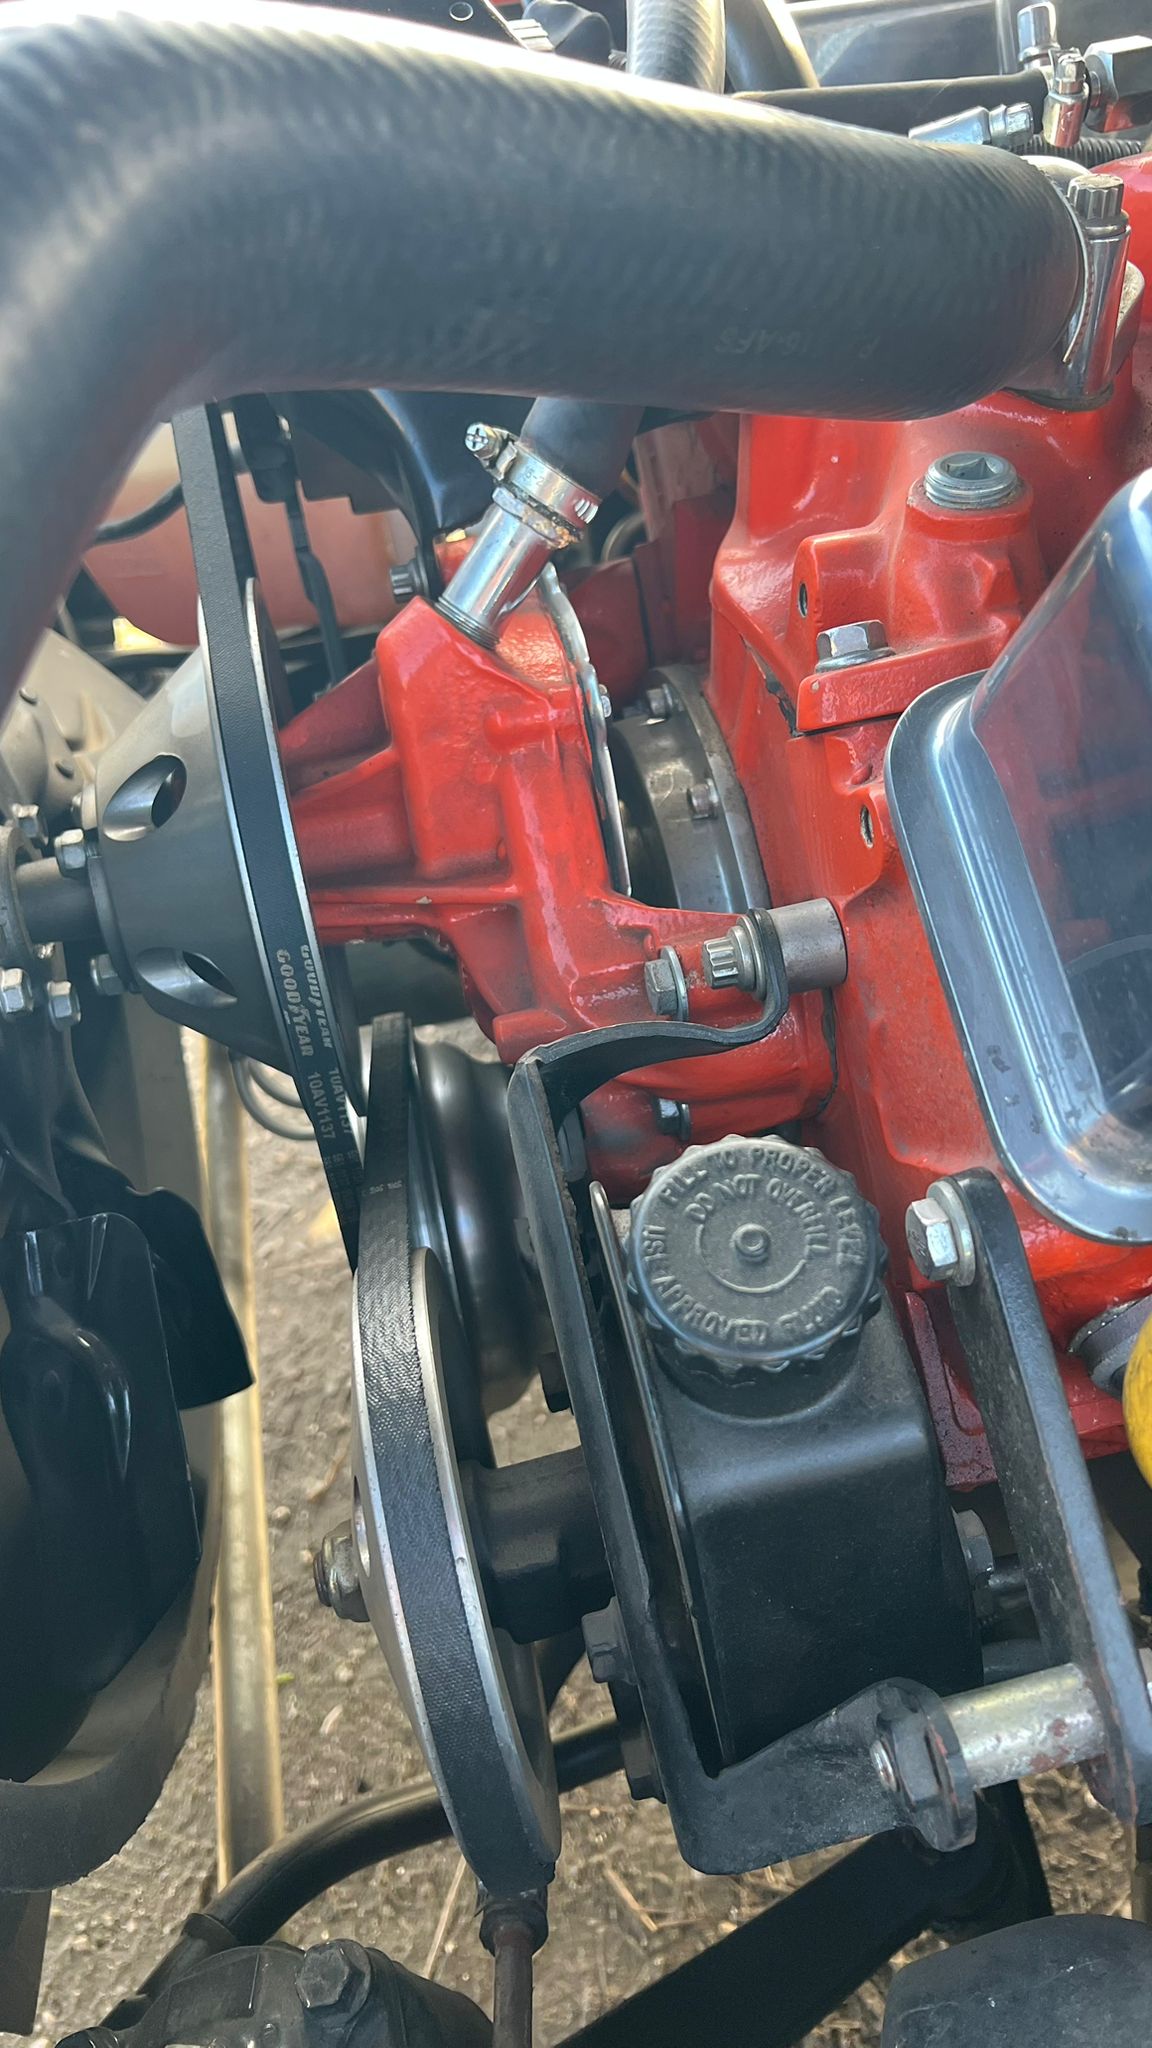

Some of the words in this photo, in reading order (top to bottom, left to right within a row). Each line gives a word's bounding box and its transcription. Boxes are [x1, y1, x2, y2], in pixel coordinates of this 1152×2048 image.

[276, 949, 314, 1056] GOODYEAR
[308, 1072, 336, 1139] 10AV1137
[659, 1170, 707, 1204] FILL
[708, 1150, 737, 1169] TO
[751, 1148, 836, 1194] PROPER
[829, 1196, 864, 1265] LEVEL
[685, 1193, 715, 1220] DO
[714, 1174, 761, 1200] NOT
[767, 1178, 830, 1252] OVERFILL
[652, 1275, 769, 1344] APPROVED
